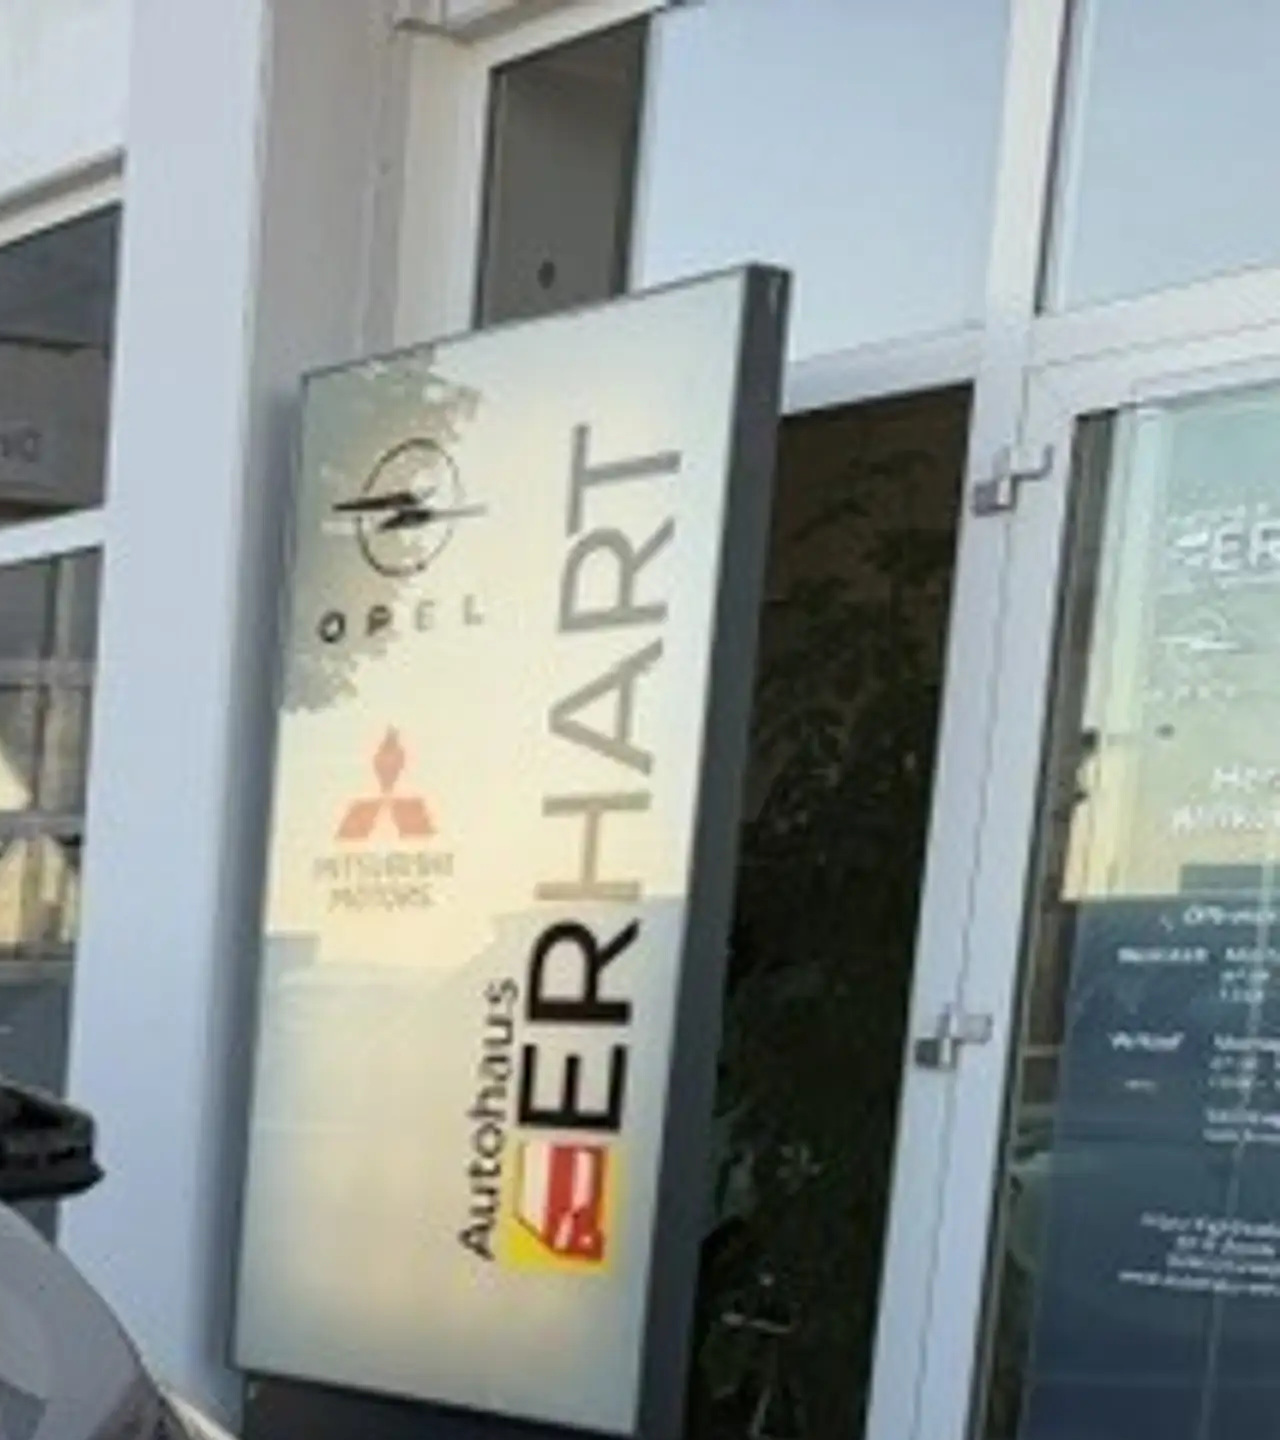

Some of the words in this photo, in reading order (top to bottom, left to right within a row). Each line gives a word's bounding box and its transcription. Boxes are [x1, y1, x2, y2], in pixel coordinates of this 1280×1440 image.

[316, 594, 485, 644] OPEL
[517, 421, 684, 1133] ERHART
[458, 975, 520, 1262] Autohaus
